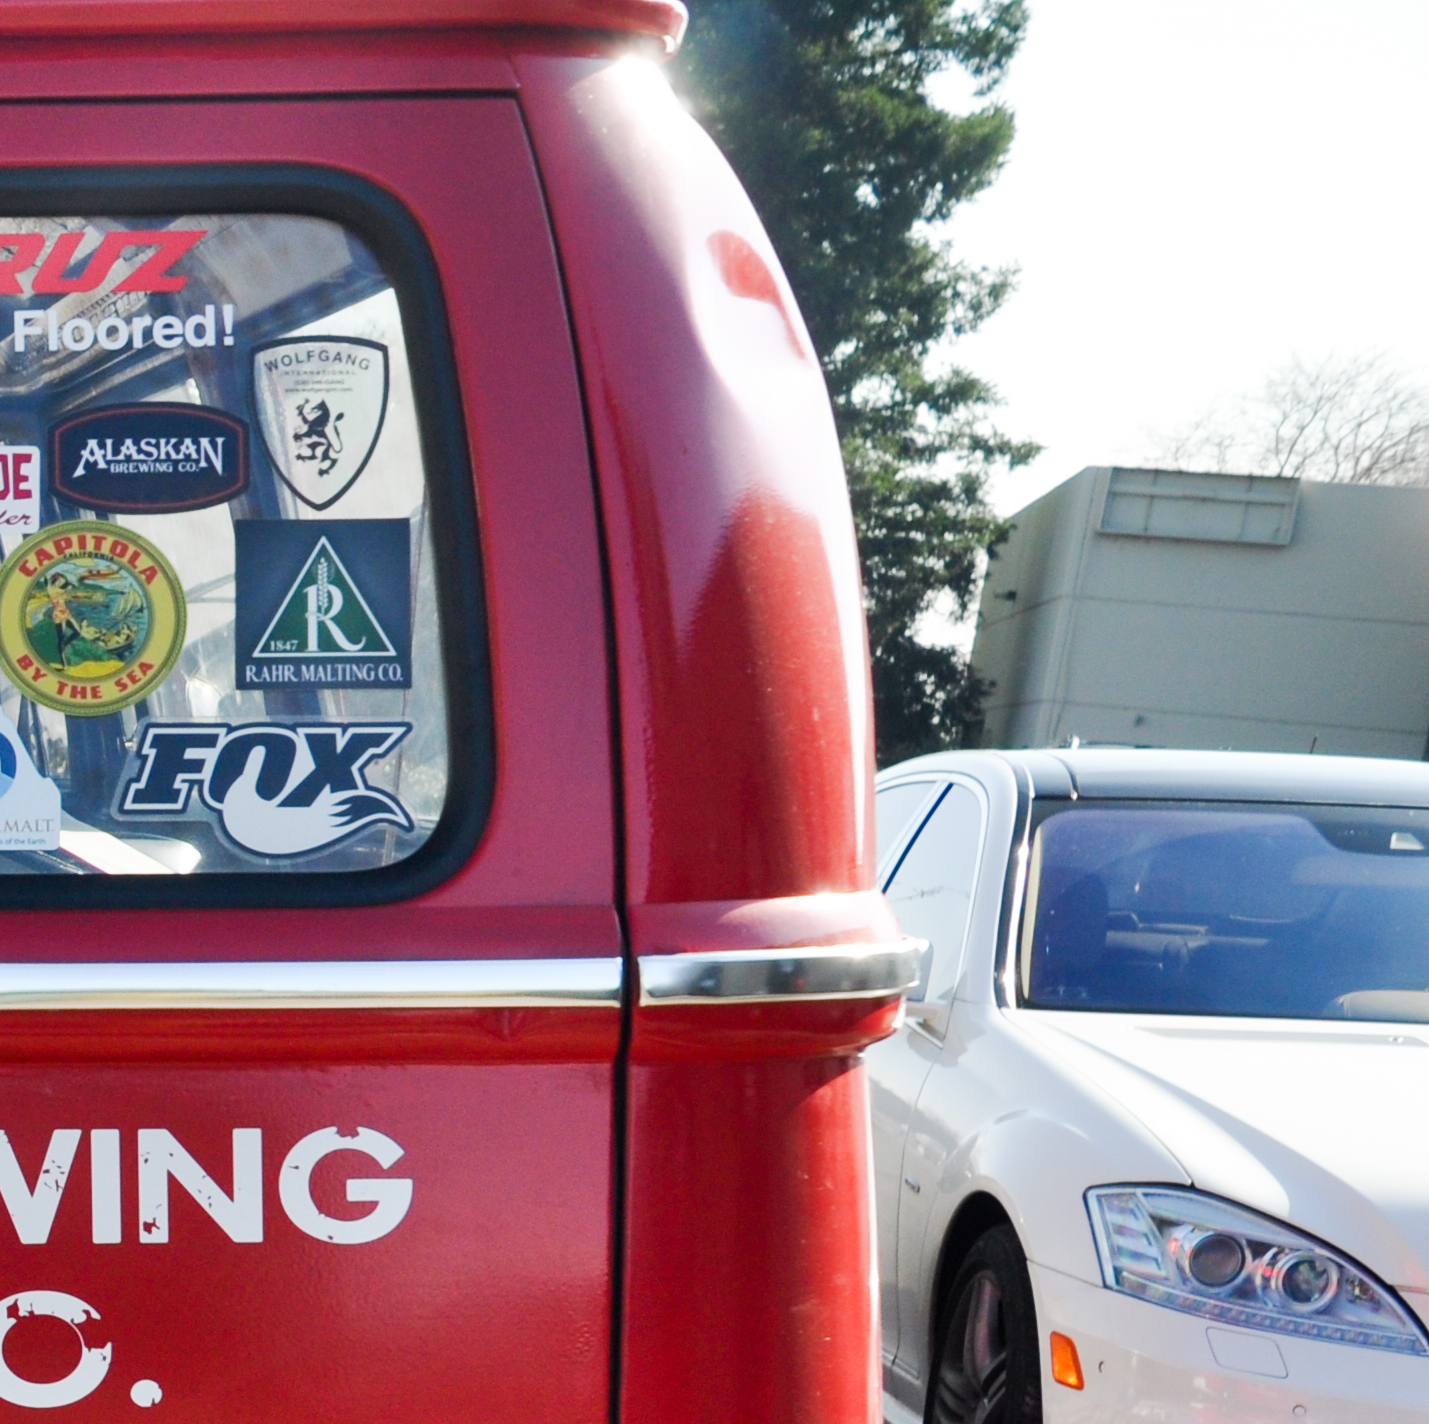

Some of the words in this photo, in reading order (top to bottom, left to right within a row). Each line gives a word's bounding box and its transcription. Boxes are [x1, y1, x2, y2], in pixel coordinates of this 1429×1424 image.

[13, 303, 236, 354] Floored!
[264, 349, 371, 372] WOLFGANG
[72, 437, 226, 479] ALASKAN
[110, 461, 173, 474] BREWING
[178, 461, 200, 473] CO.
[18, 534, 159, 586] CAPITOLA
[63, 551, 115, 562] CALIFORNIA
[270, 640, 299, 651] 1847
[16, 654, 48, 683] BY
[56, 681, 103, 700] THE
[114, 660, 155, 693] SEA
[245, 664, 299, 683] RAHR
[301, 663, 375, 682] MALTING
[378, 663, 404, 682] CO.
[121, 721, 415, 815] FOX
[5, 837, 13, 845] of
[14, 837, 25, 845] the
